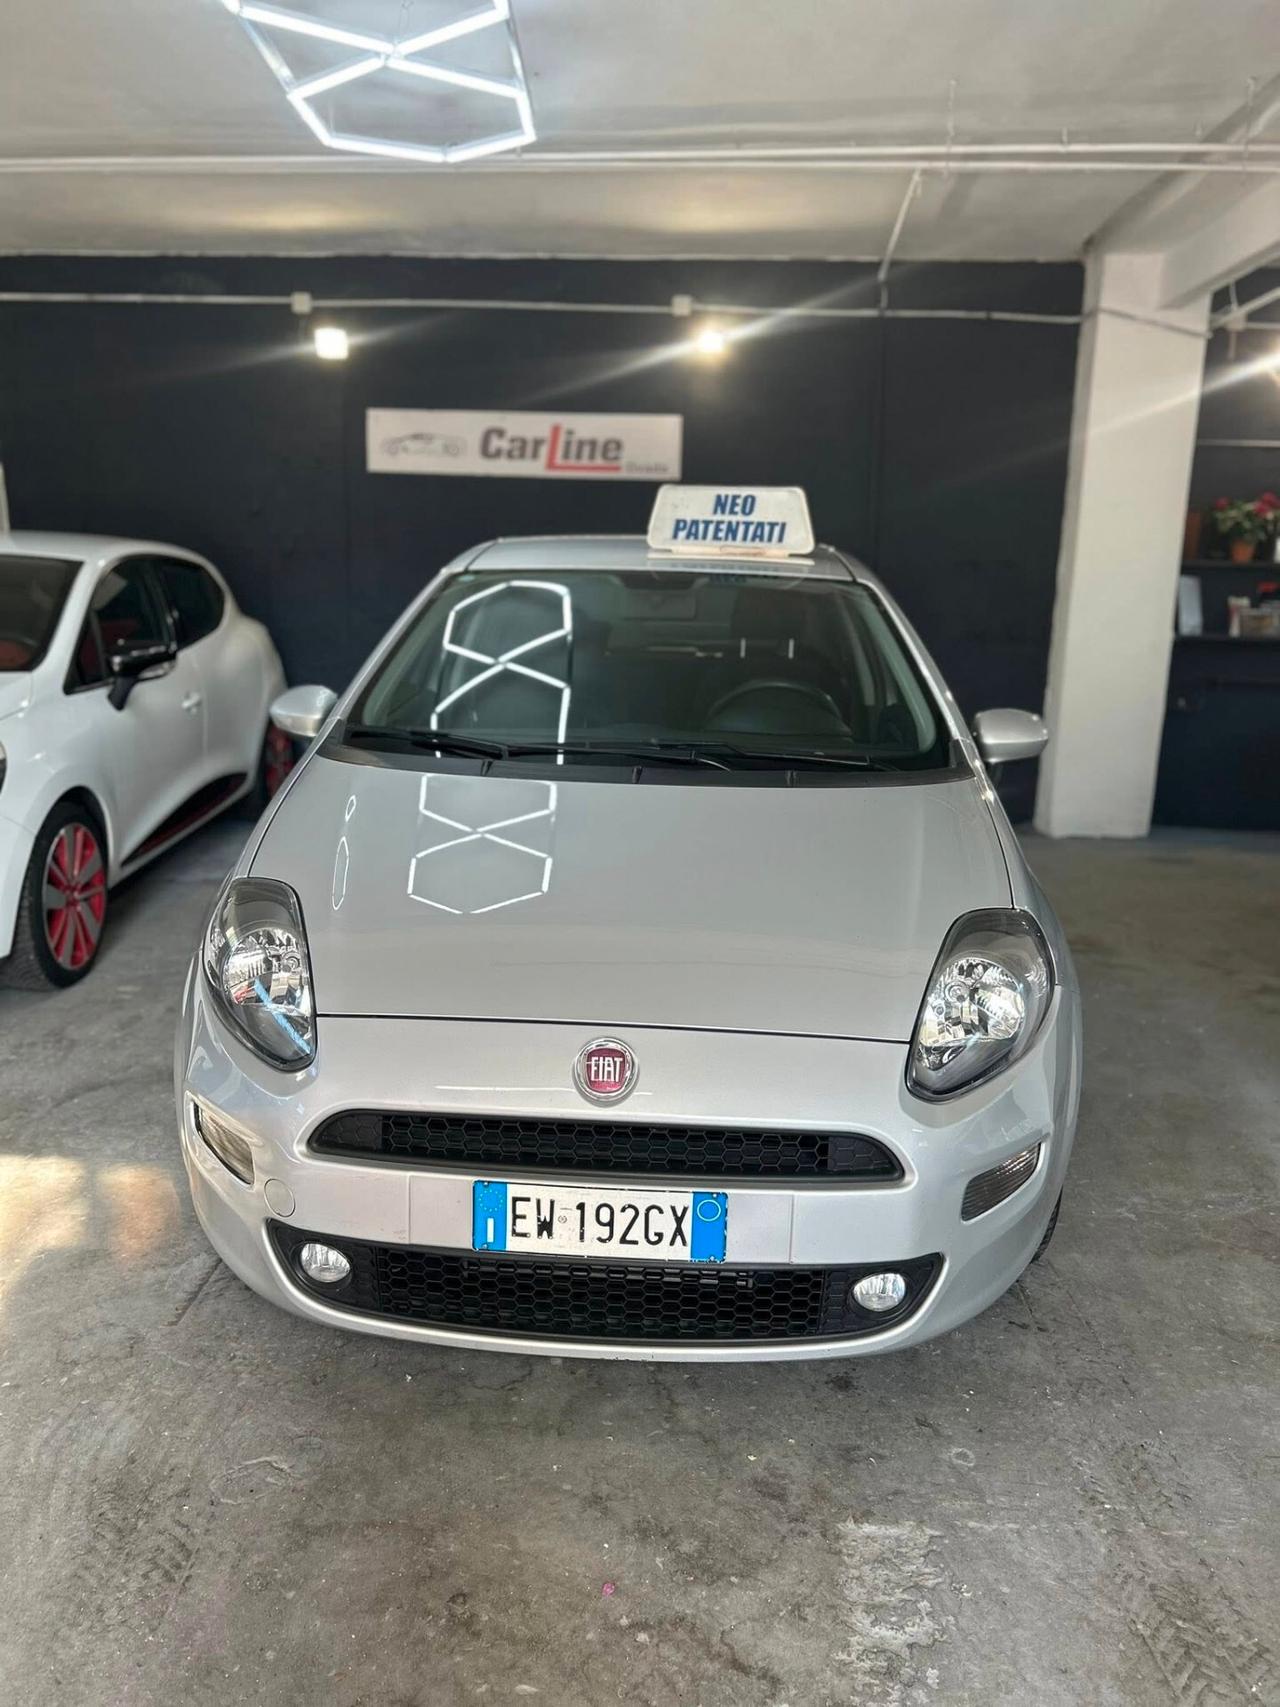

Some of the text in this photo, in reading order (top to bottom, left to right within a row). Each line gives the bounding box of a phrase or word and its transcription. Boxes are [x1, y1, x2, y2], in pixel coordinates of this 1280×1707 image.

[480, 424, 622, 472] CarLine
[713, 494, 756, 516] NEO
[672, 518, 787, 543] PATENTATI
[591, 1056, 623, 1082] FIAT
